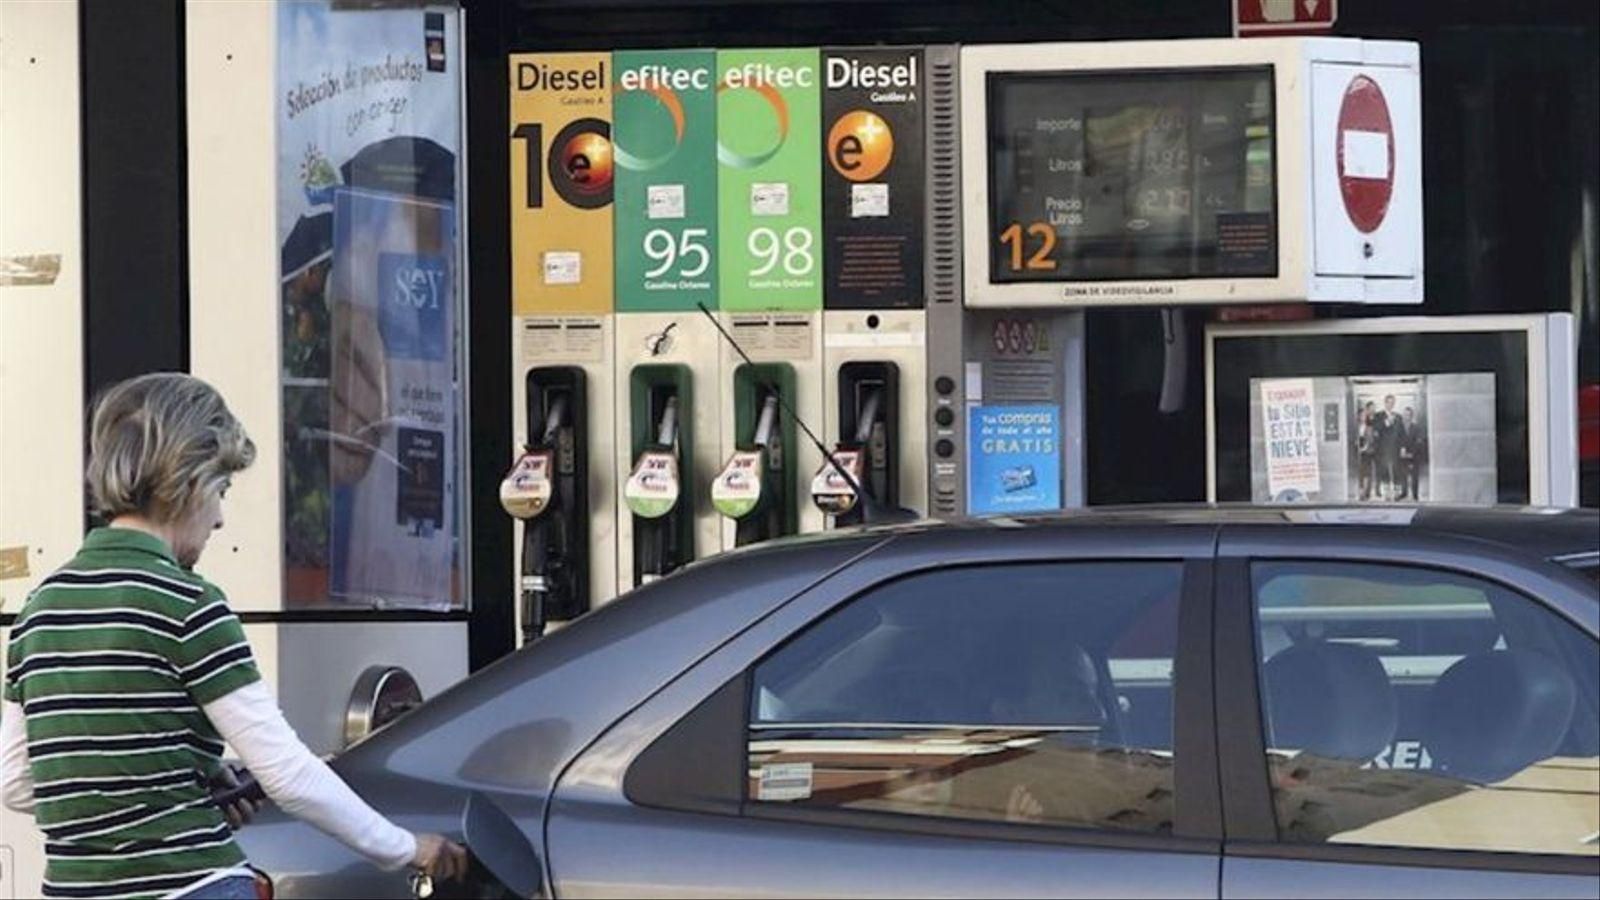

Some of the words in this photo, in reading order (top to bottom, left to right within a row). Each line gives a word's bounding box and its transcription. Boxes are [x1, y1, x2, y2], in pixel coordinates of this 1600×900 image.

[518, 62, 604, 91] Diesel
[621, 66, 709, 90] efitec
[725, 64, 813, 88] efitec
[827, 58, 917, 88] Diesel
[512, 117, 614, 210] 10
[643, 228, 711, 279] 95
[748, 226, 814, 276] 98
[1000, 223, 1057, 271] 12
[981, 438, 1053, 455] GRATIS
